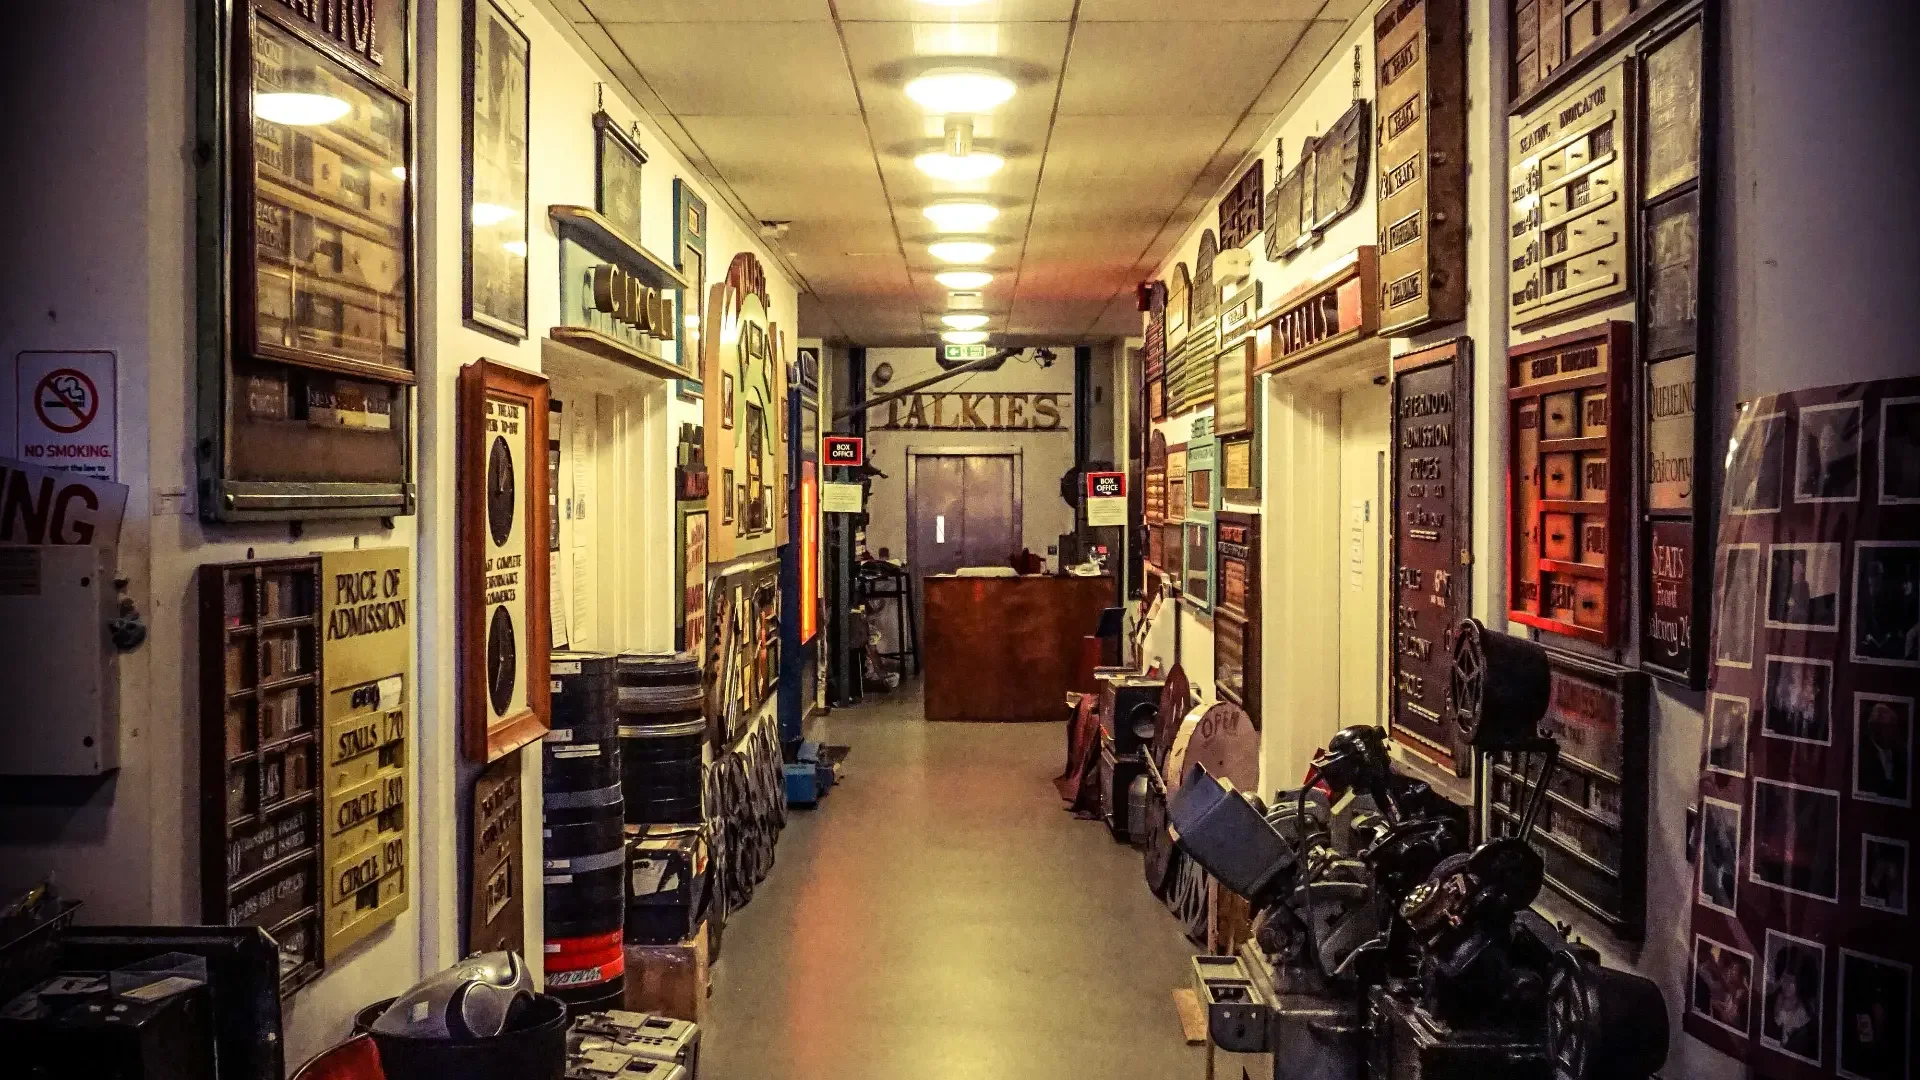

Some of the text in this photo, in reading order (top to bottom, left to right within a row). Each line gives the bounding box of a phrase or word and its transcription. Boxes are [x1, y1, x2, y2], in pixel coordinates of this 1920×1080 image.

[1519, 123, 1551, 154] SEATING
[1559, 86, 1606, 129] INDICATOR
[1279, 292, 1335, 357] STALLS
[884, 393, 1061, 430] TALKIES
[24, 445, 44, 458] NO
[832, 450, 854, 458] OFFICE
[1403, 424, 1450, 449] ADMISSION
[0, 467, 98, 545] NG
[1096, 484, 1119, 492] OFFICE
[1652, 536, 1683, 578] SEATS
[336, 568, 401, 605] PRICE OF
[327, 599, 407, 641] ADMISSION
[339, 723, 378, 759] STALLS
[1202, 708, 1240, 740] OPEN
[337, 790, 378, 827] CIRCLE
[339, 855, 379, 896] CIRCLE
